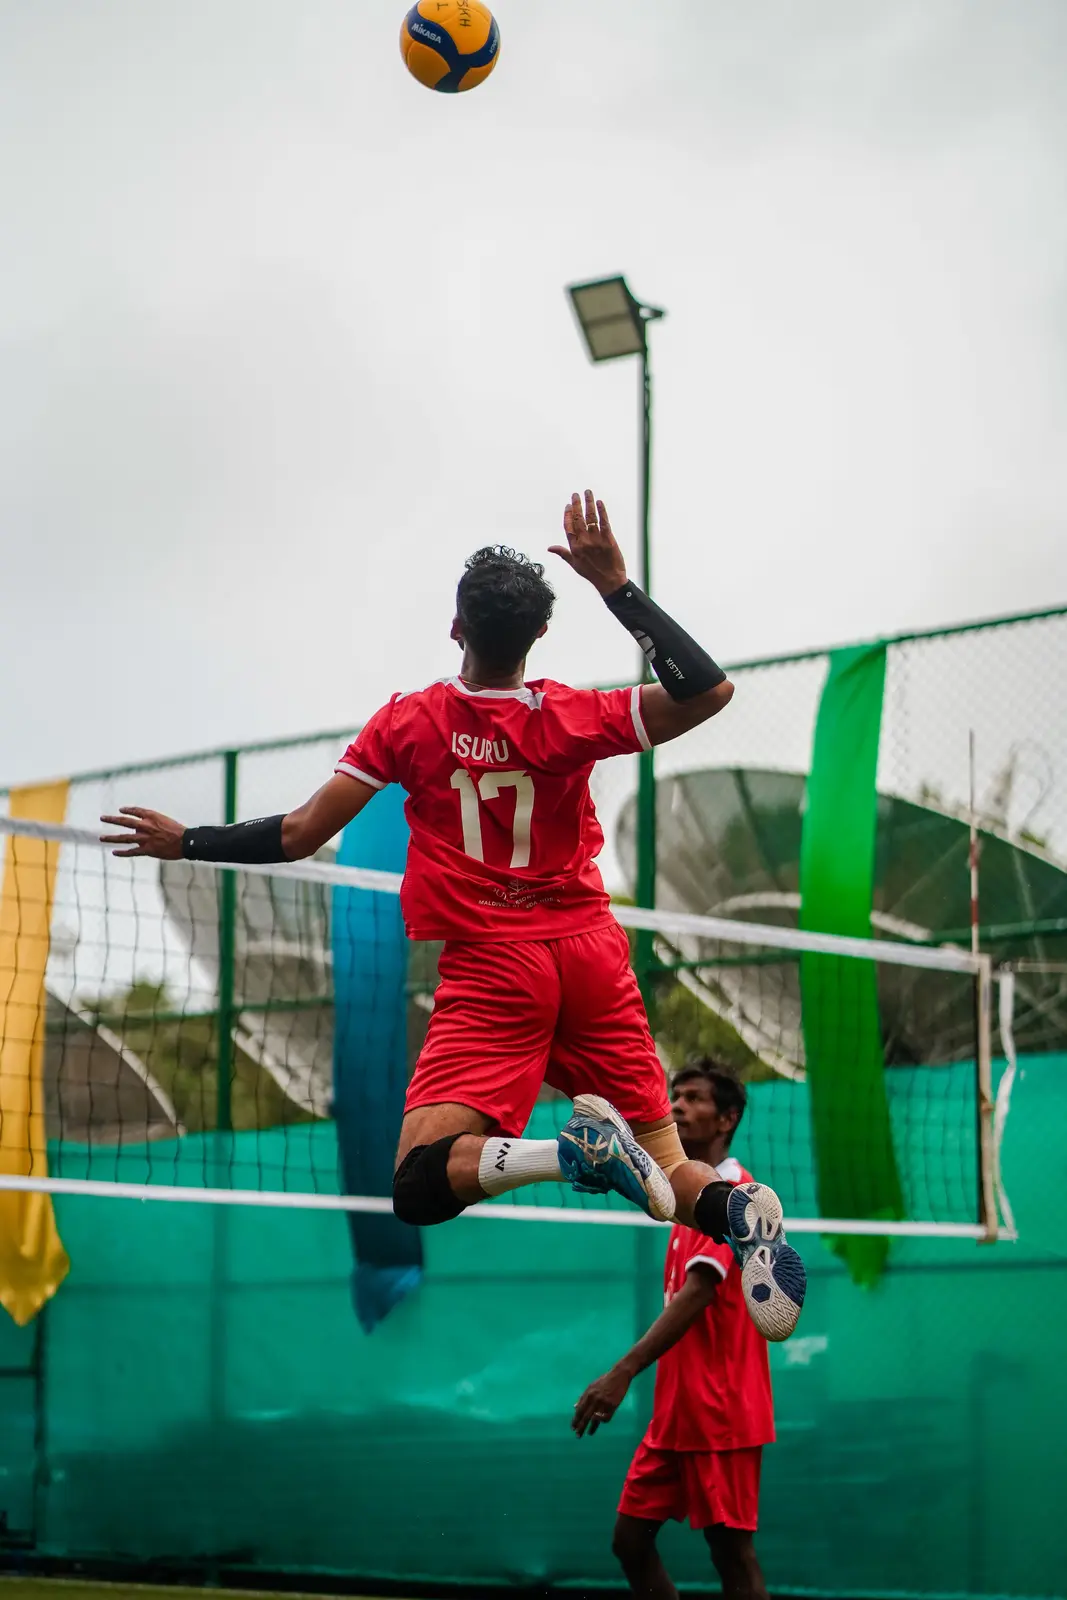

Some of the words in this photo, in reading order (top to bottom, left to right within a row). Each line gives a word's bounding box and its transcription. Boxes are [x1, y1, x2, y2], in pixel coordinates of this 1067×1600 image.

[664, 657, 686, 680] ALLSIX
[451, 731, 509, 763] ISURU
[450, 768, 535, 869] 17
